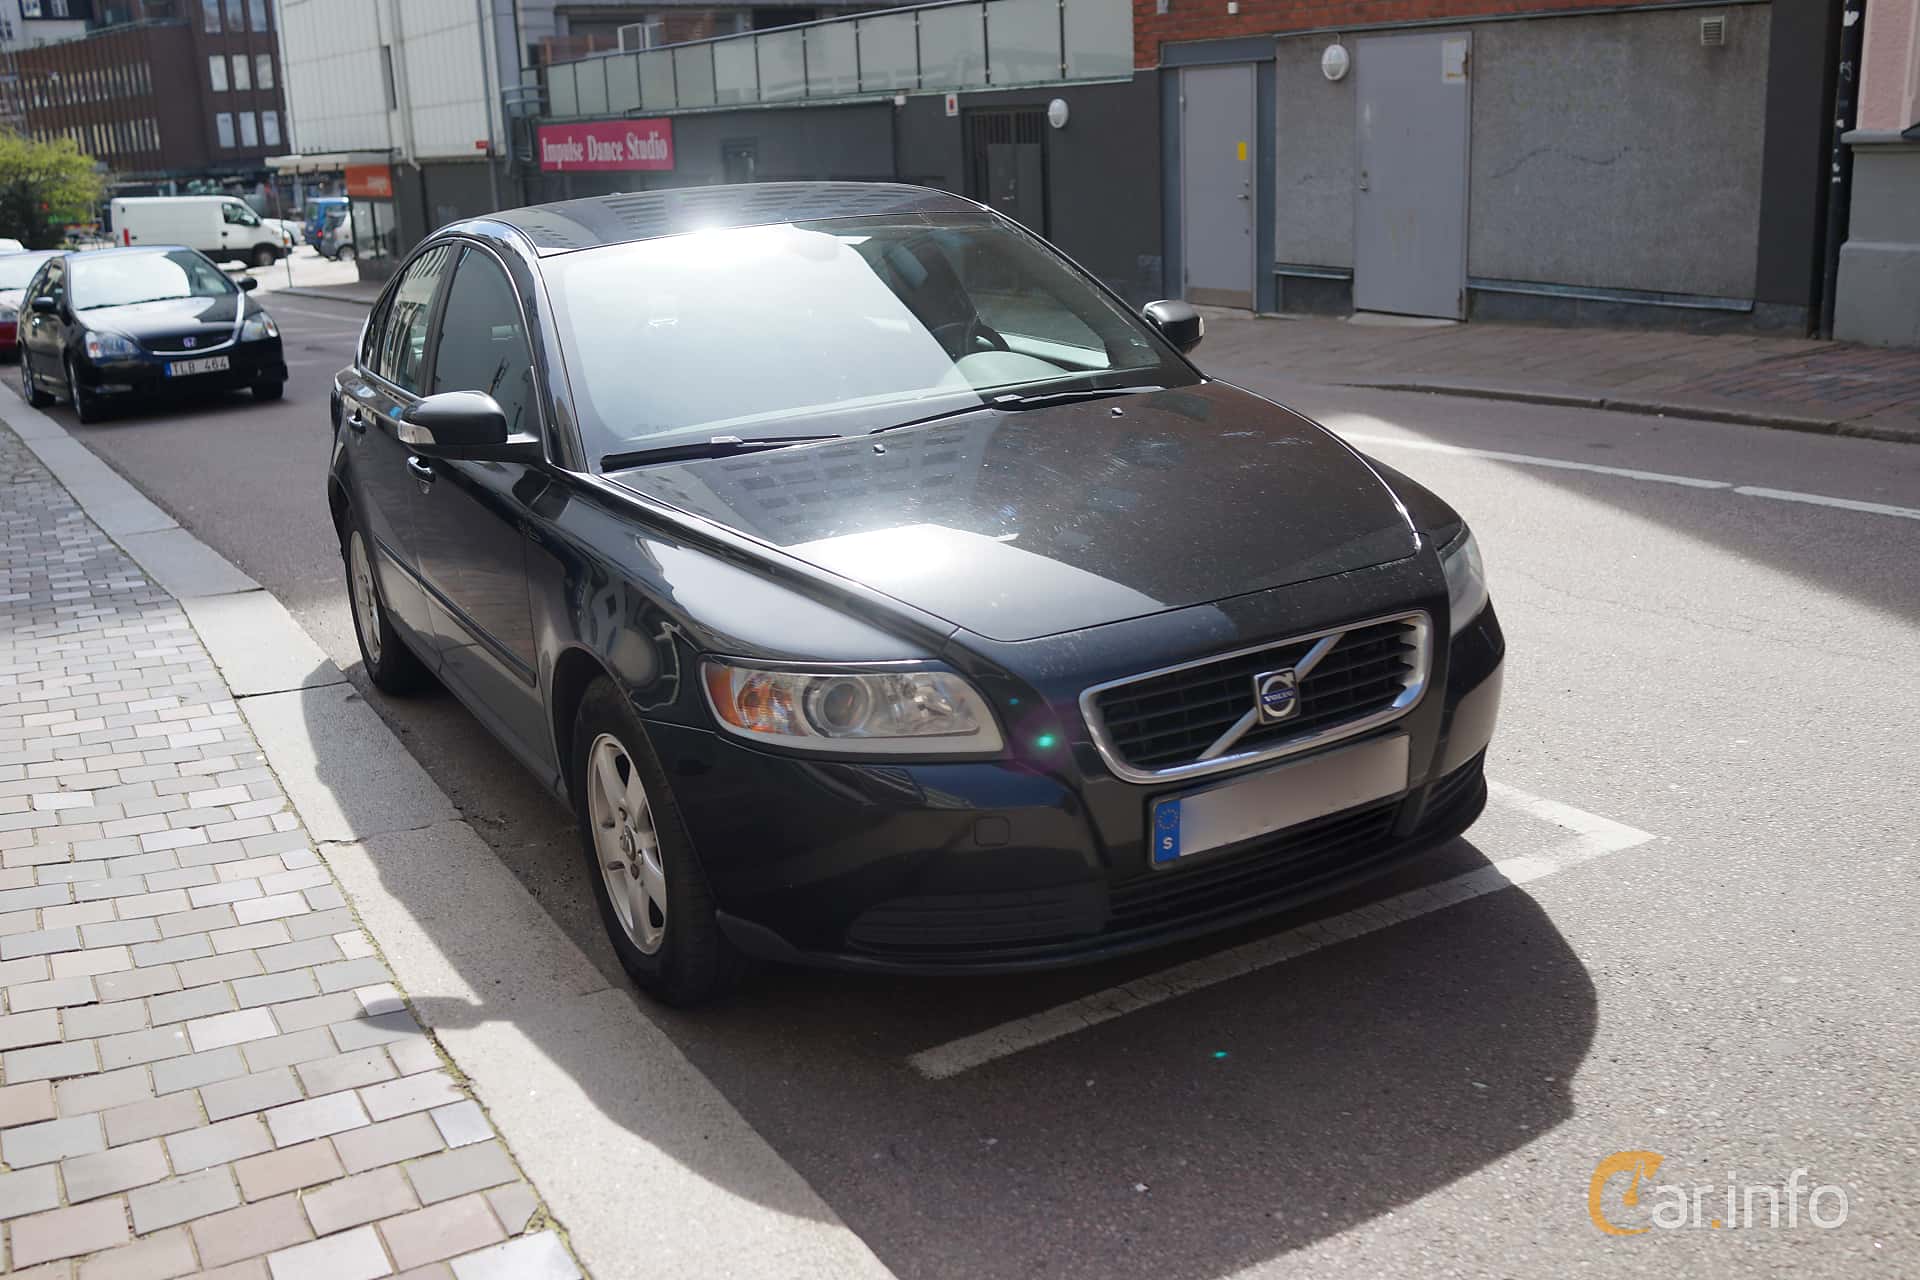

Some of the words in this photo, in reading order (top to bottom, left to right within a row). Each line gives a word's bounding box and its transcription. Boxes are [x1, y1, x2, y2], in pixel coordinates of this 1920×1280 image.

[542, 136, 584, 169] Impulse
[586, 134, 624, 163] Dance
[626, 131, 668, 162] Studio
[1263, 690, 1294, 702] VOLVO
[1162, 837, 1173, 850] S
